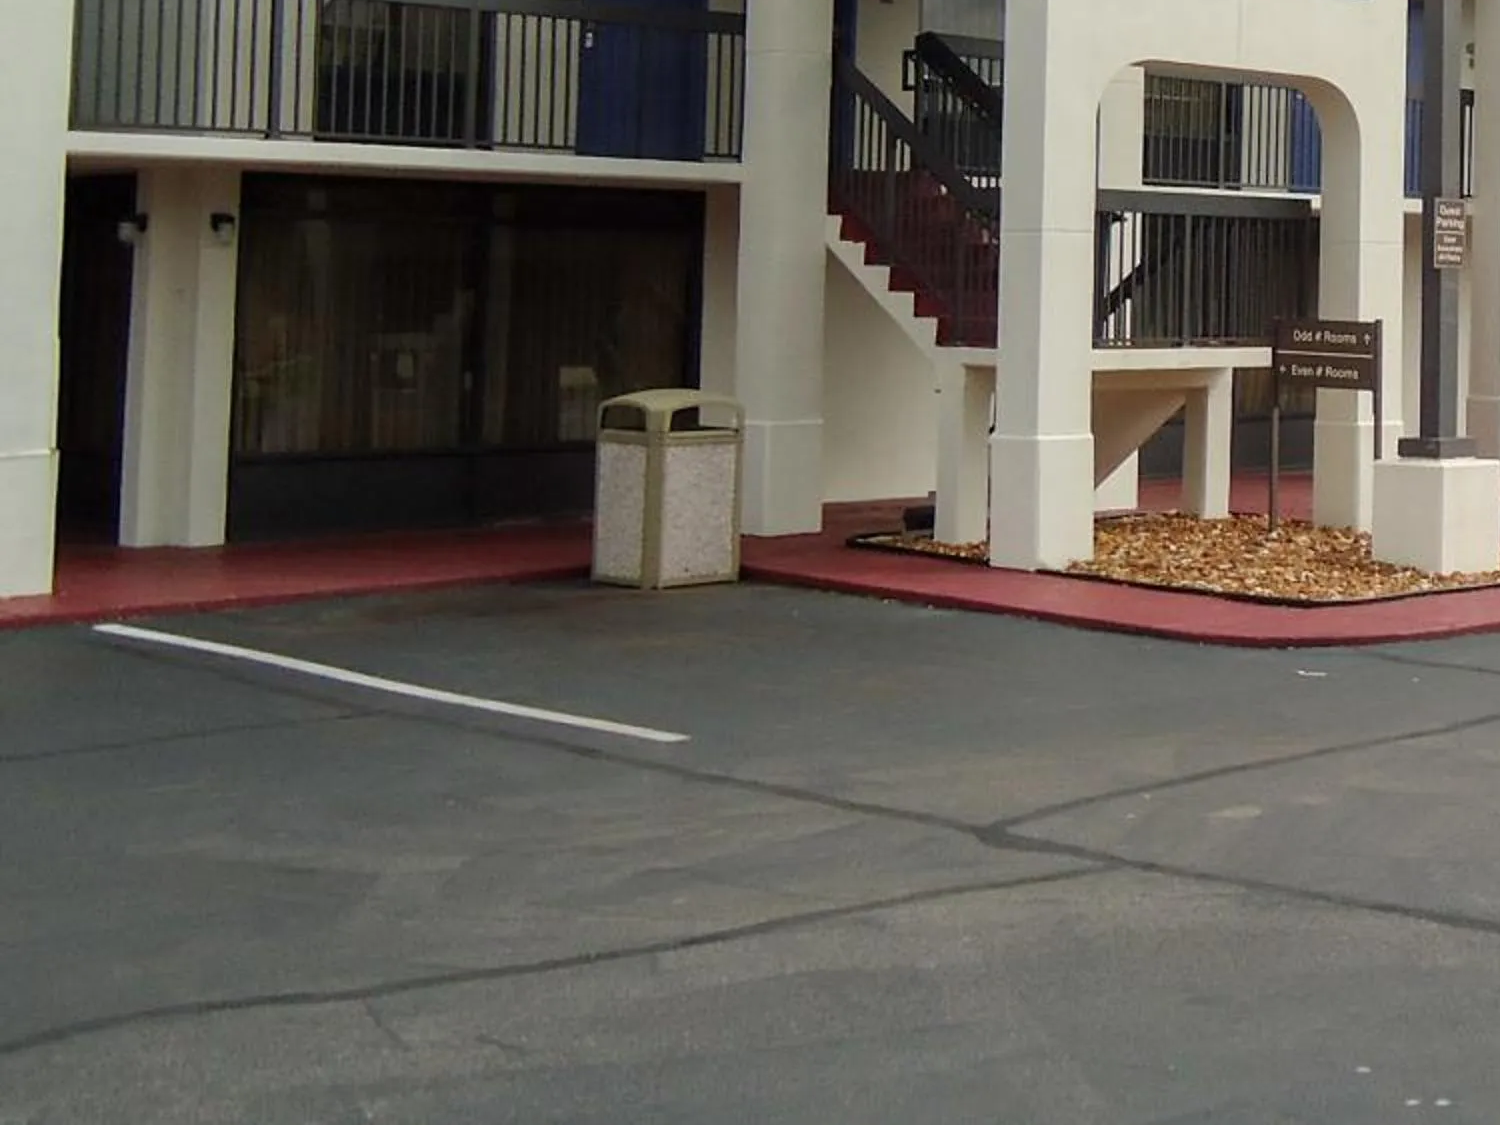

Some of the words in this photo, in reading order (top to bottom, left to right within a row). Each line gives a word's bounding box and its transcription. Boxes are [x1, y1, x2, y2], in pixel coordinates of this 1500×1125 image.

[1437, 217, 1465, 231] Parking
[1293, 329, 1313, 343] Odd
[1324, 330, 1357, 345] Rooms
[1291, 364, 1315, 377] Even
[1325, 366, 1359, 380] Rooms
